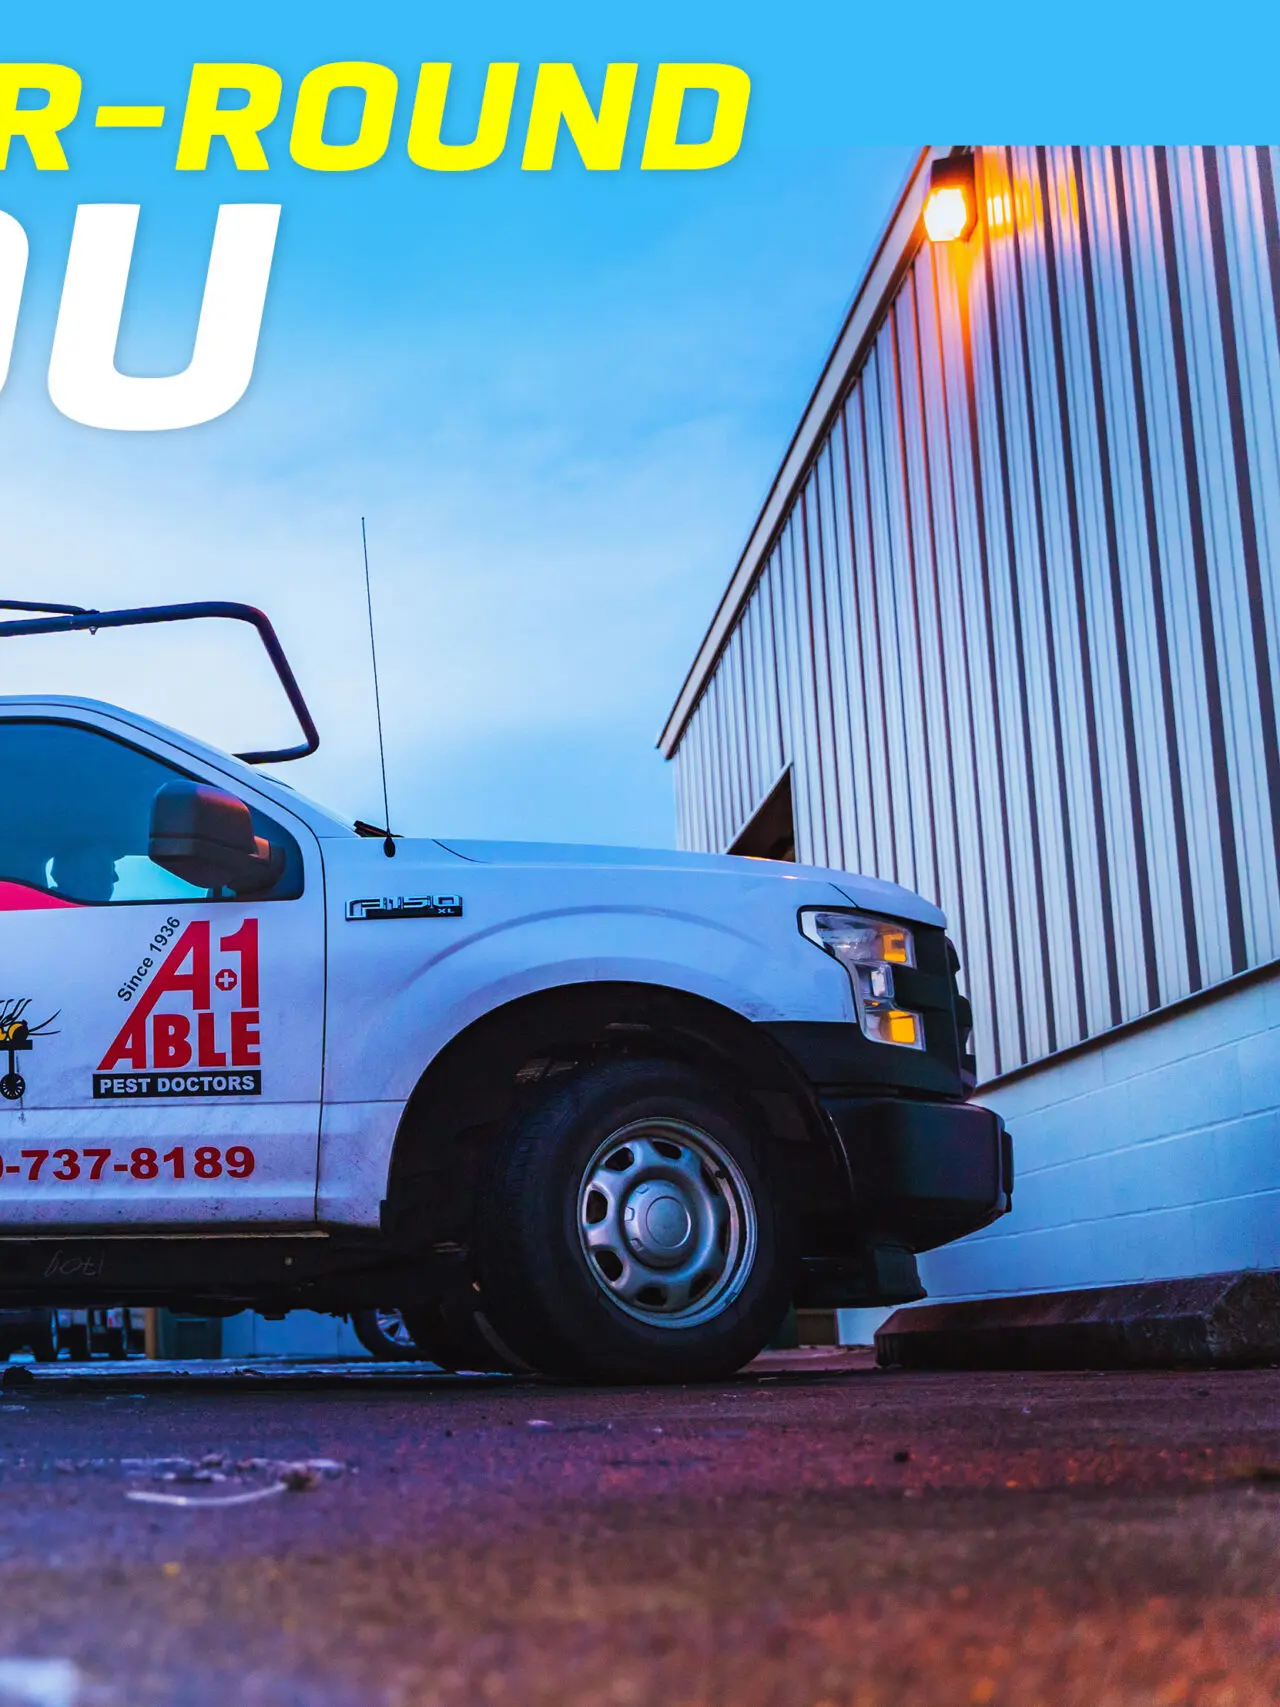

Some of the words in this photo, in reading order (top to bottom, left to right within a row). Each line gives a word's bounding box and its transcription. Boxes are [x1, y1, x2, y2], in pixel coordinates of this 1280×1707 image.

[117, 957, 154, 1002] Since
[149, 916, 181, 953] 1936
[96, 1010, 261, 1070] ABLE
[100, 1078, 151, 1094] PEST
[157, 1075, 255, 1092] DOCTORS
